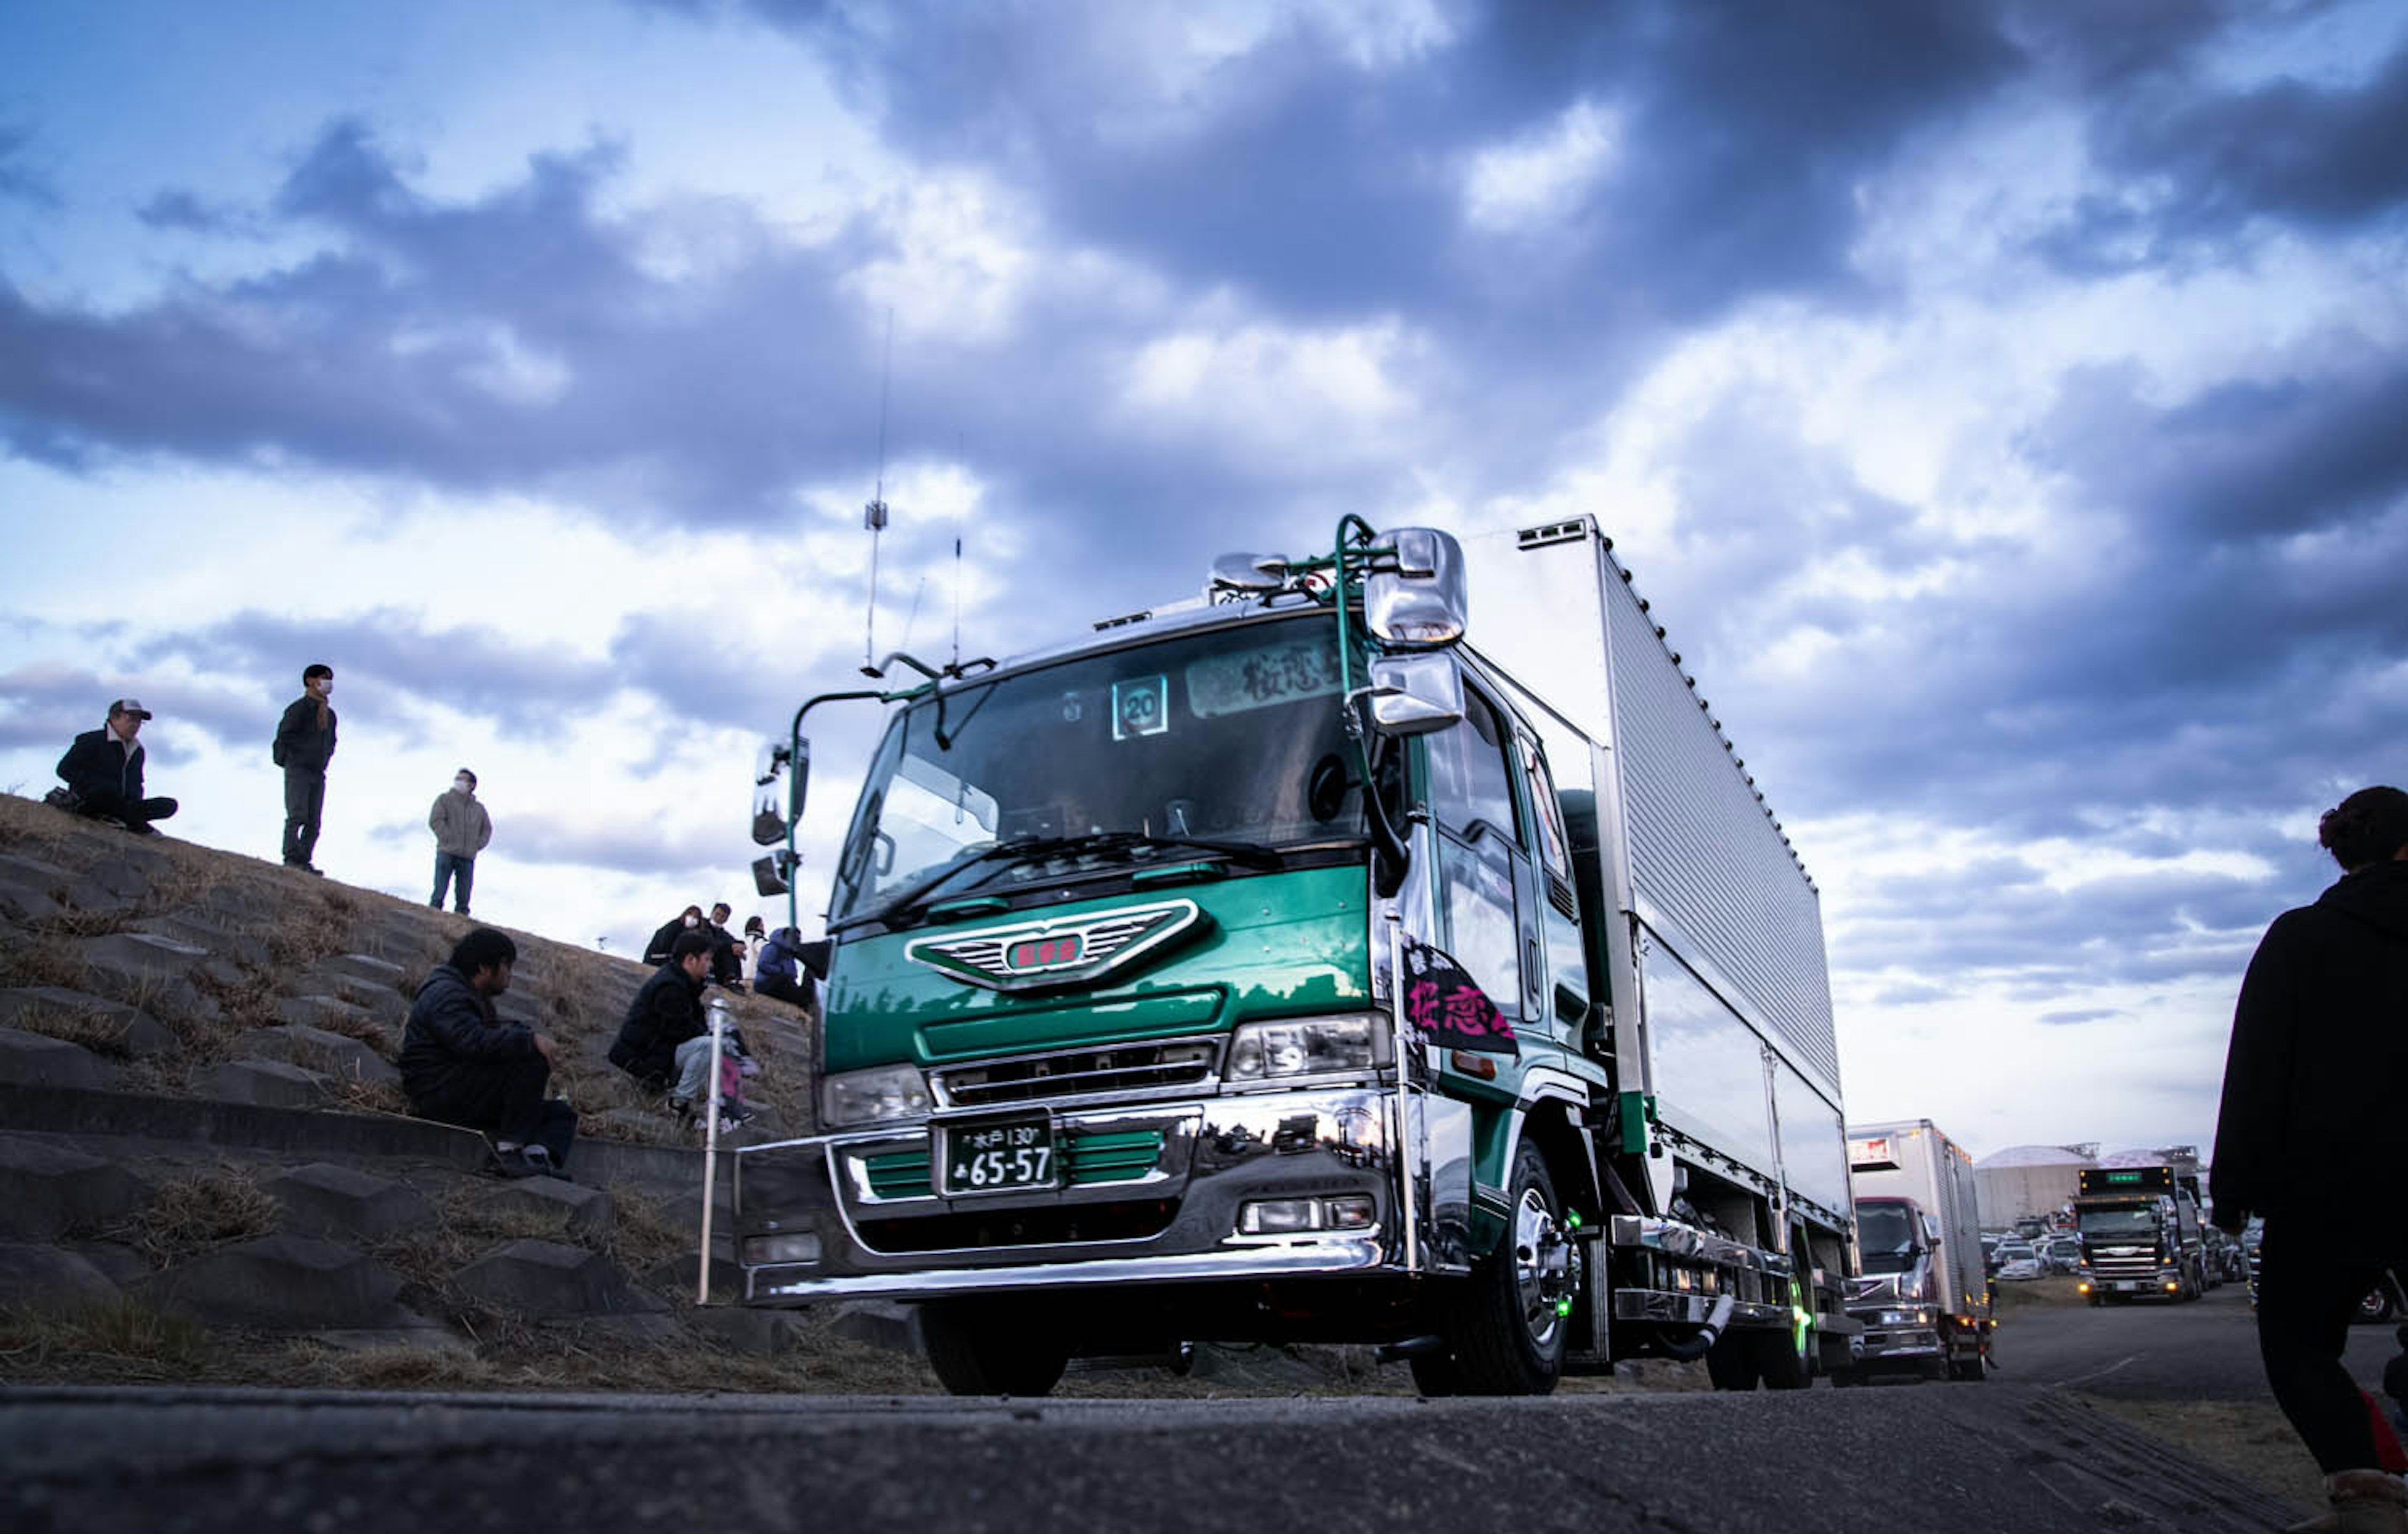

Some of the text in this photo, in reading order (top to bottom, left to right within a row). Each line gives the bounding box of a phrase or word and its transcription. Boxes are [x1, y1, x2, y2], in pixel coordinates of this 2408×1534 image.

[1127, 693, 1155, 720] 20
[1006, 1127, 1034, 1146] 130
[970, 1147, 1050, 1185] 65-57
